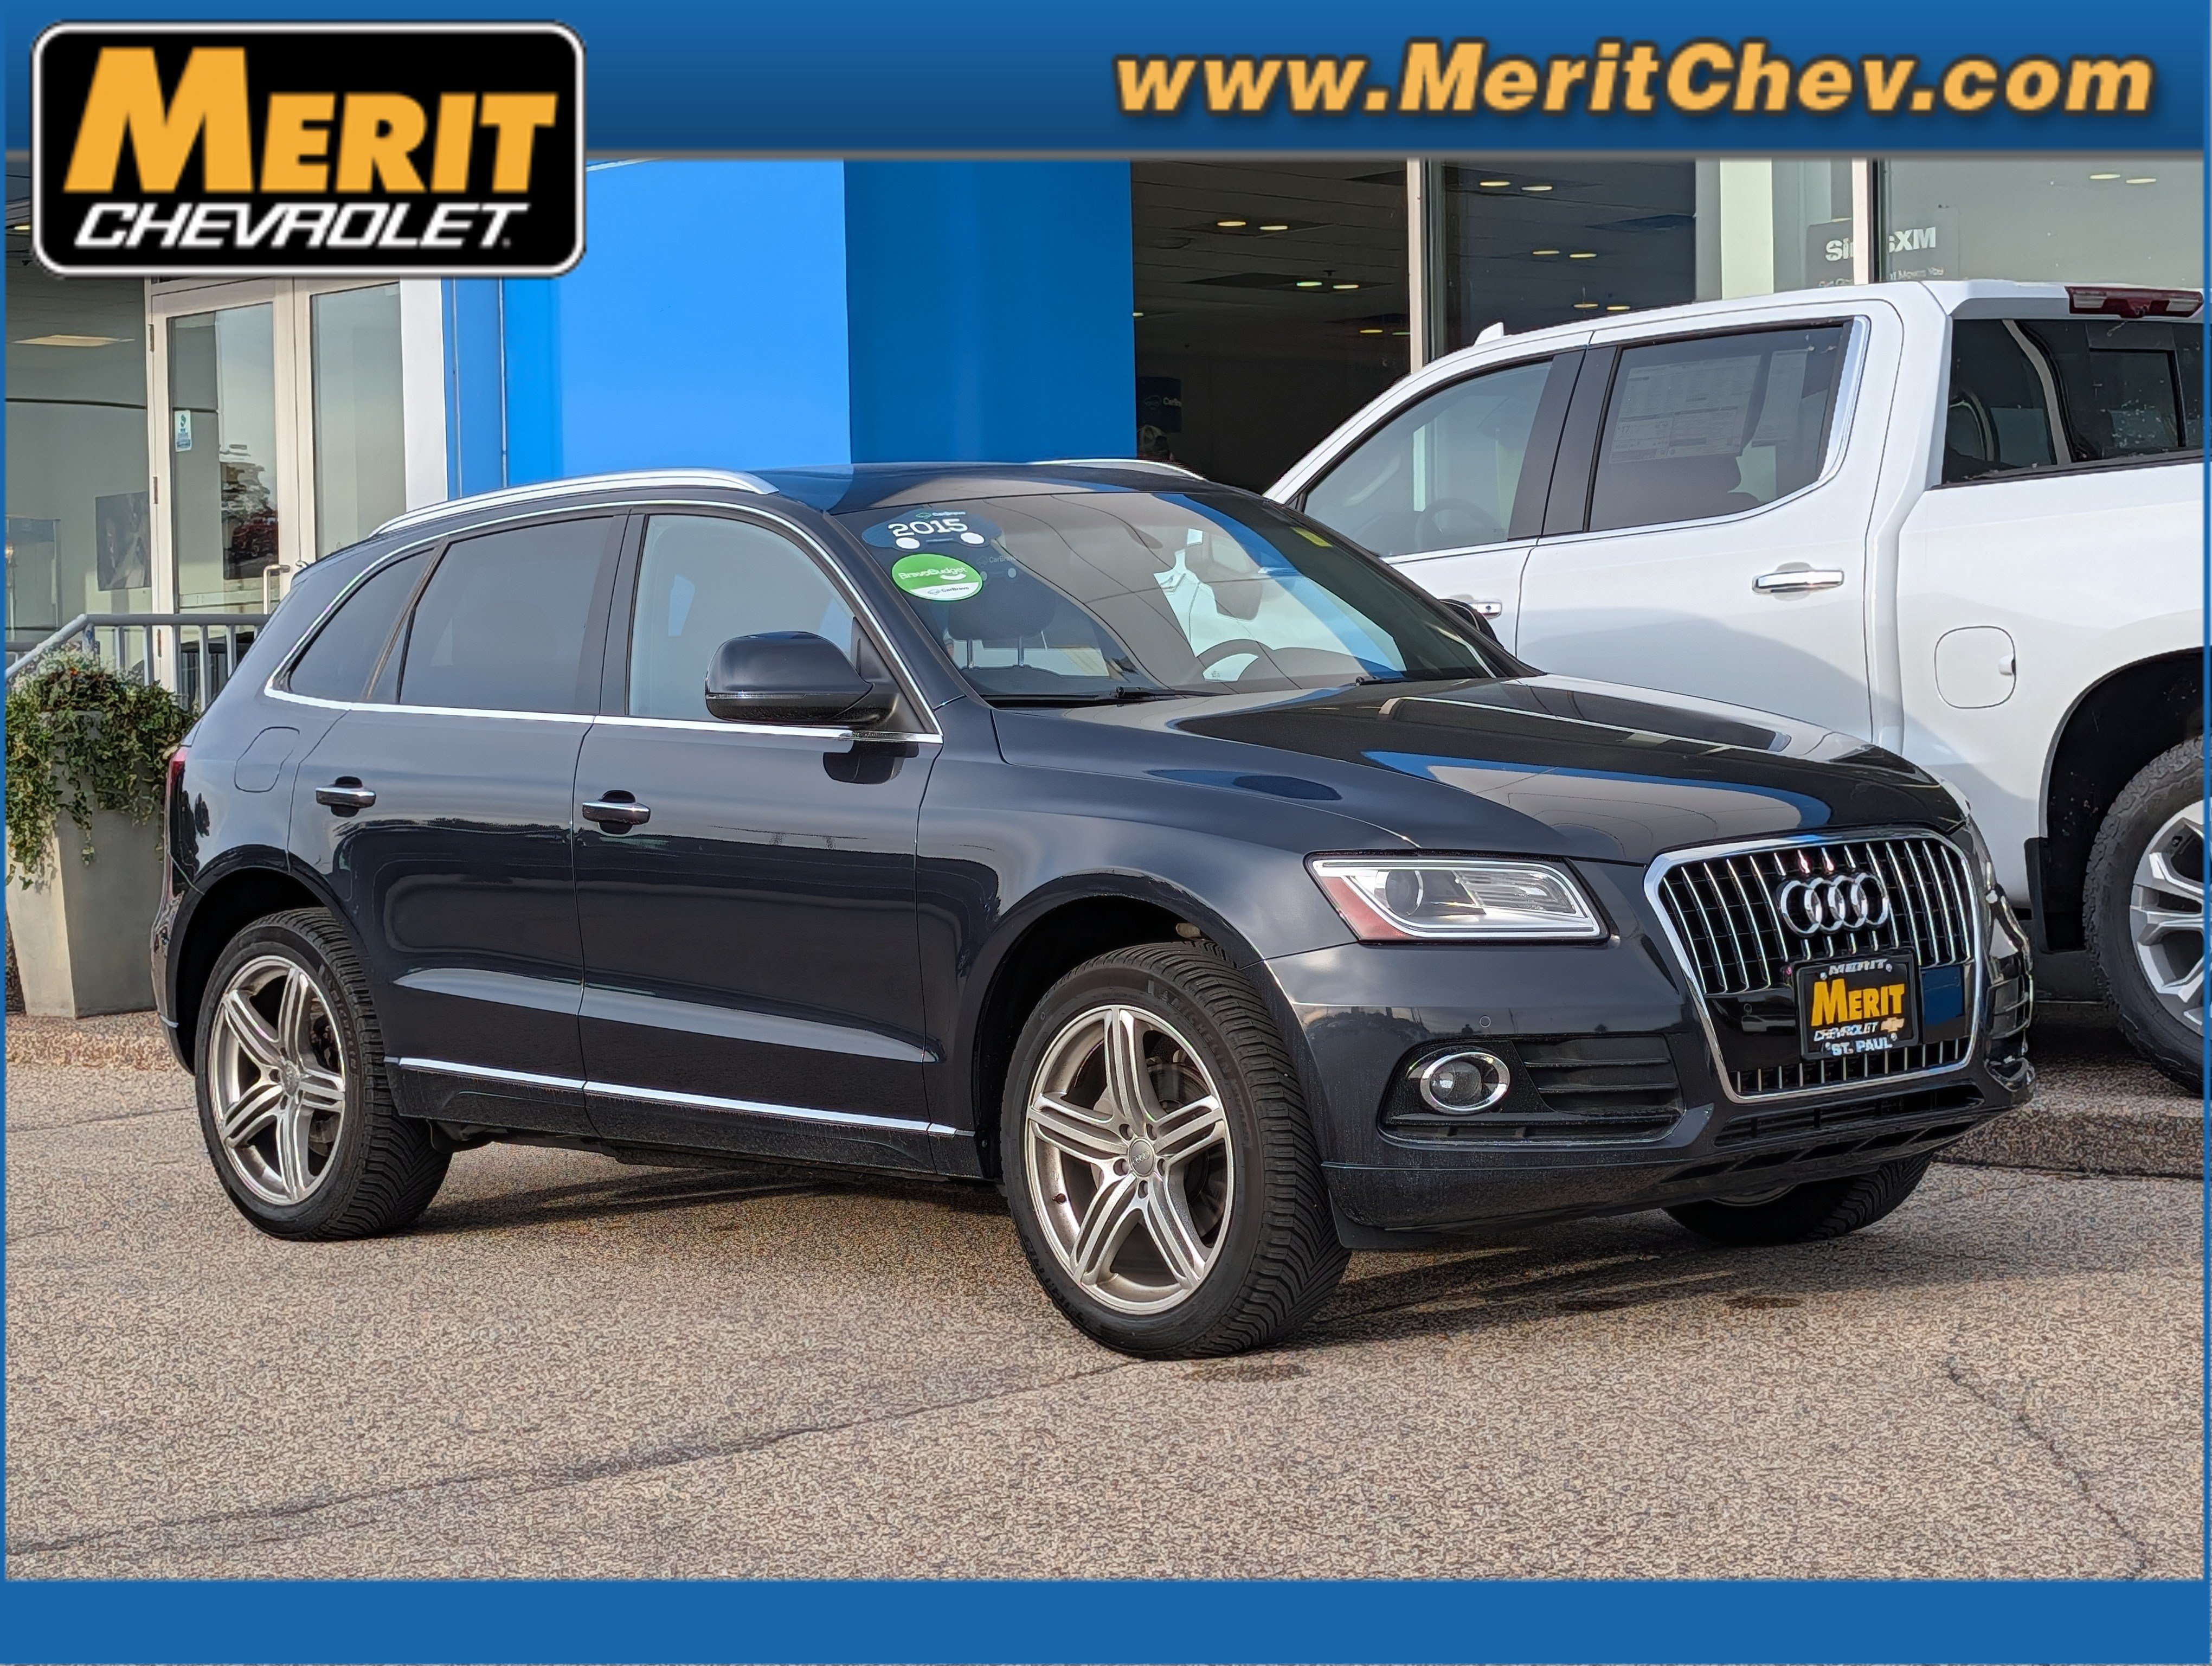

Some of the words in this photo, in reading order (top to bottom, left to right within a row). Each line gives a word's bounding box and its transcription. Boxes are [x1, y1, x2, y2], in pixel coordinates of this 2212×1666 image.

[888, 518, 968, 537] 2015
[898, 567, 968, 580] BravoBudget
[1829, 959, 1888, 976] MERIT
[1811, 978, 1905, 1027] MERIT
[1831, 1041, 1854, 1056] ST.
[1855, 1037, 1893, 1053] PAUL
